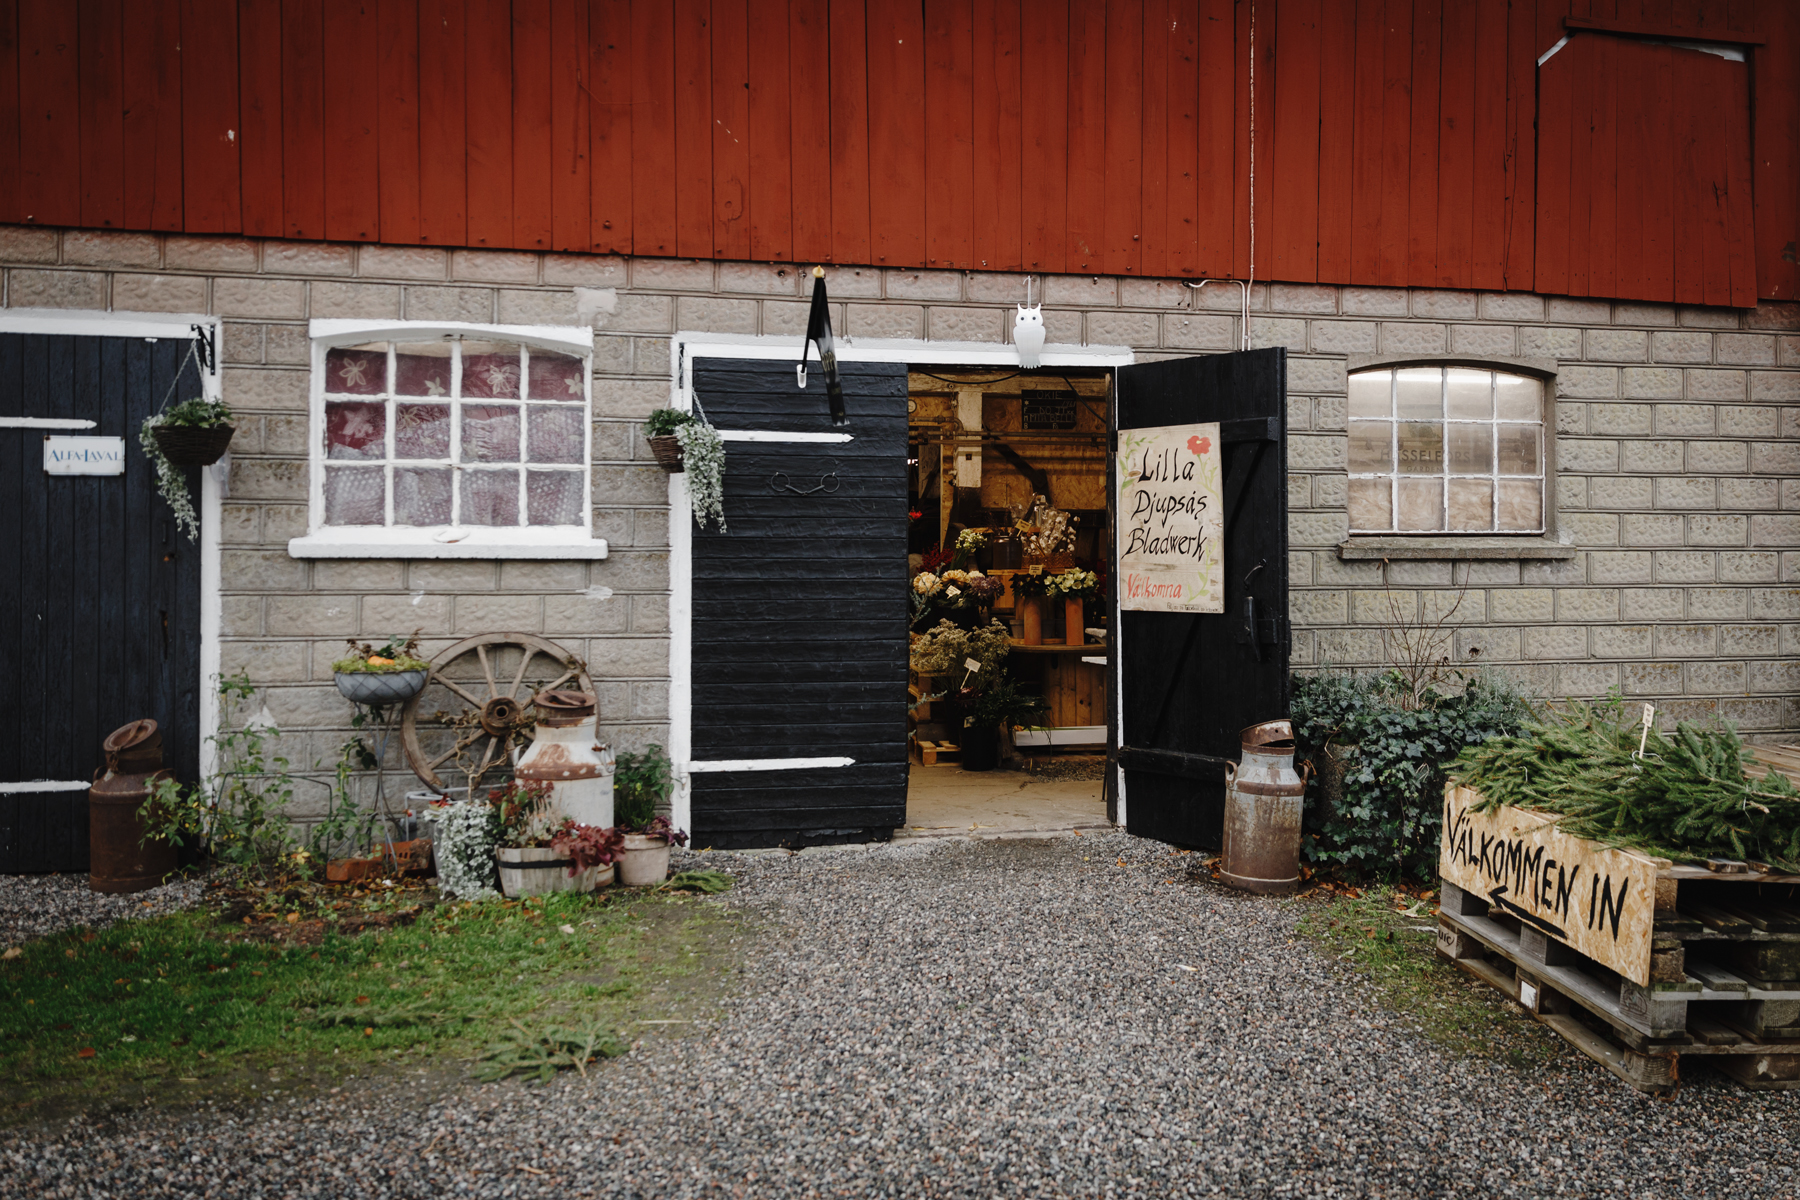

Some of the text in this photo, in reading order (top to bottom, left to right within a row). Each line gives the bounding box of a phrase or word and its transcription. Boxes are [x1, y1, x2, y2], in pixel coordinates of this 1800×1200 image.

[1037, 391, 1062, 399] OKIE
[48, 450, 121, 462] ALFA-LAVAL
[1139, 447, 1194, 482] Lilla
[1381, 450, 1470, 462] HSSELFORS
[1120, 525, 1208, 562] Bladwerk
[1127, 573, 1183, 599] Välkomna
[1446, 803, 1629, 944] VÄLKOMMEN IN
